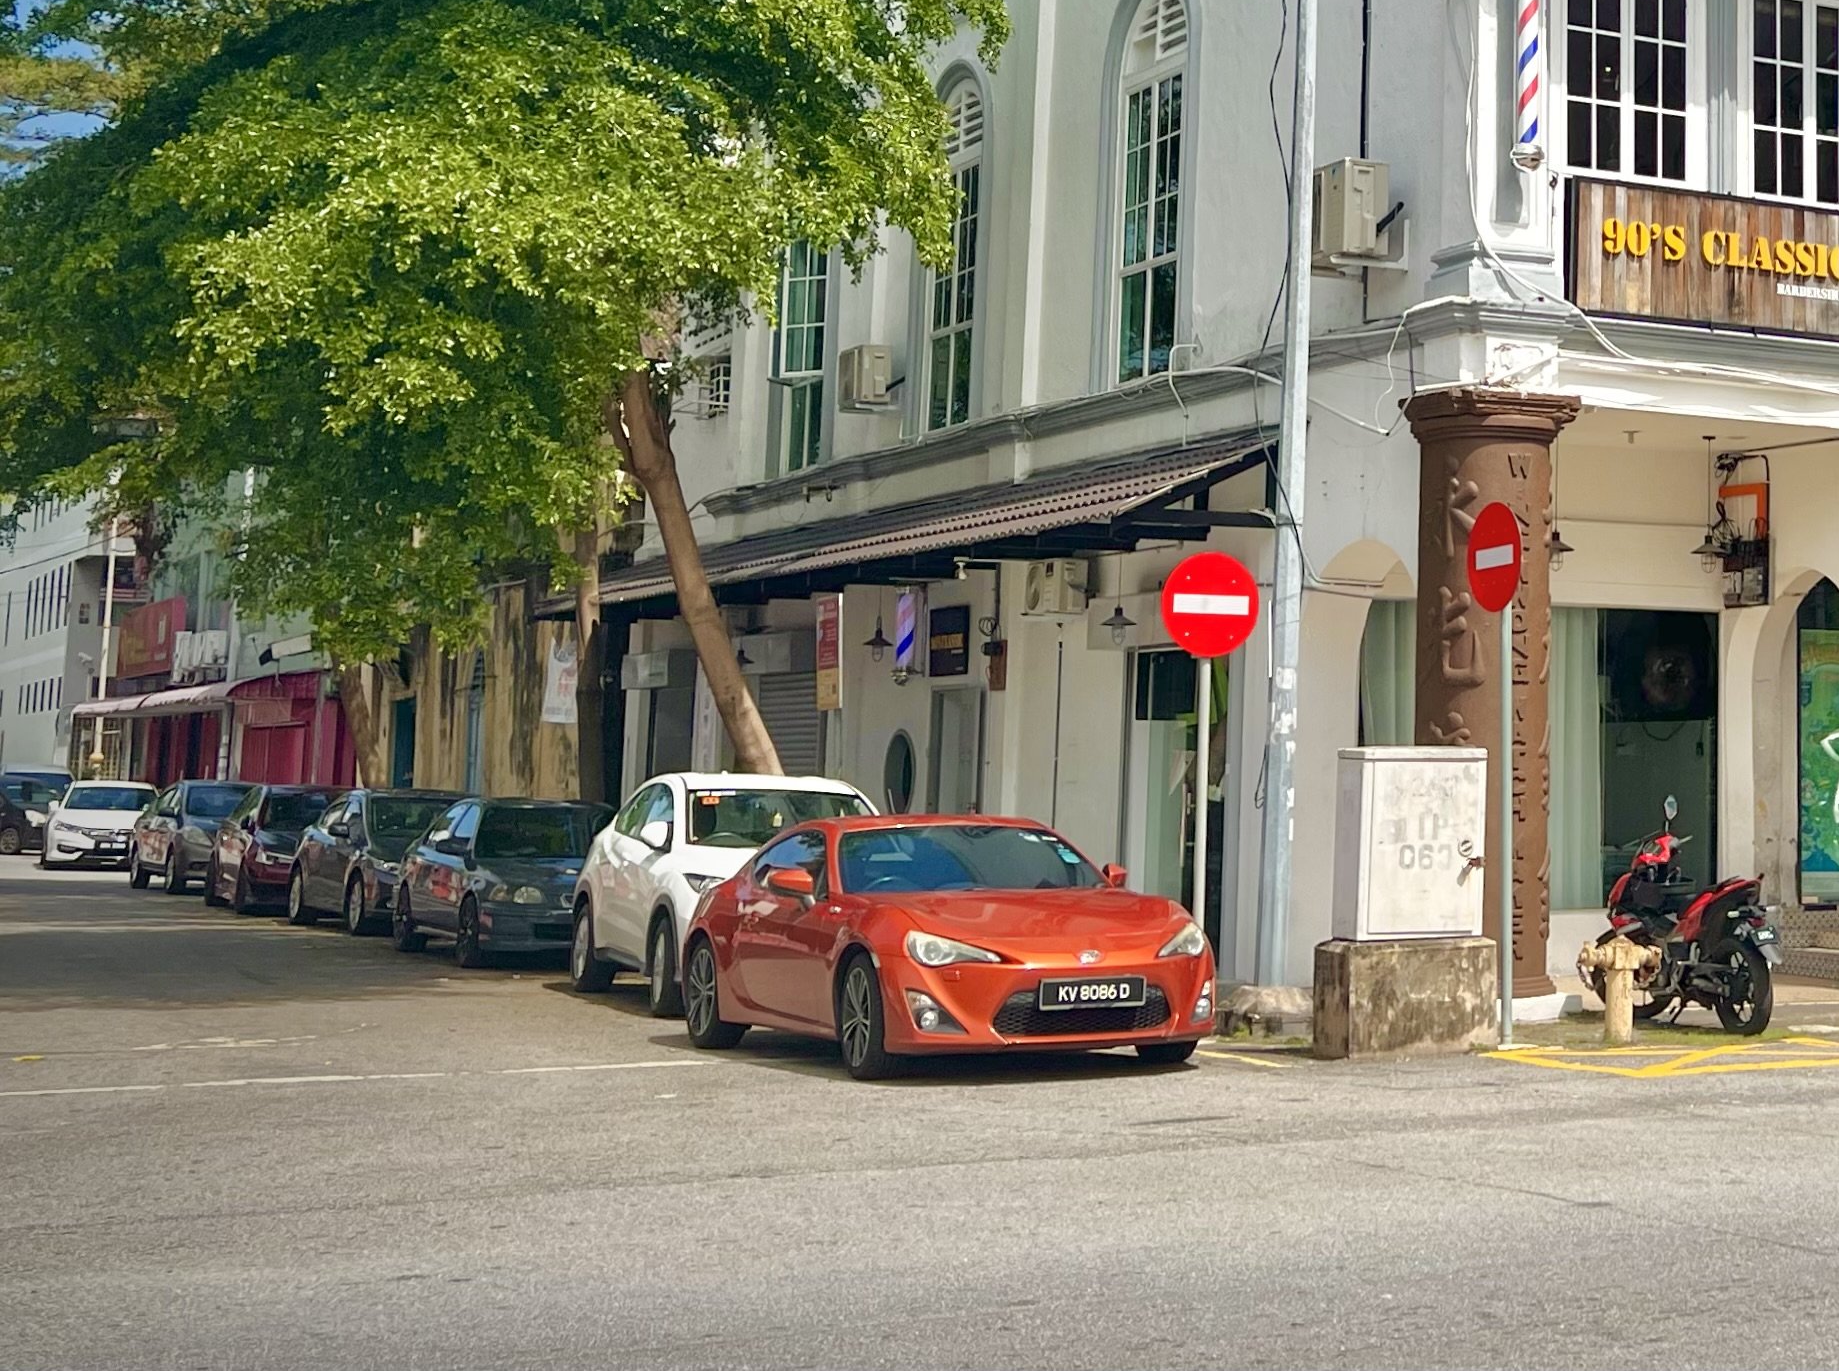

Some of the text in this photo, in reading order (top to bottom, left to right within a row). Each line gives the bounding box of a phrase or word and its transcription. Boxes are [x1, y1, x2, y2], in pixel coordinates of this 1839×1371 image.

[1602, 217, 1687, 262] 90'S
[1058, 983, 1130, 1002] KV 8086 D
